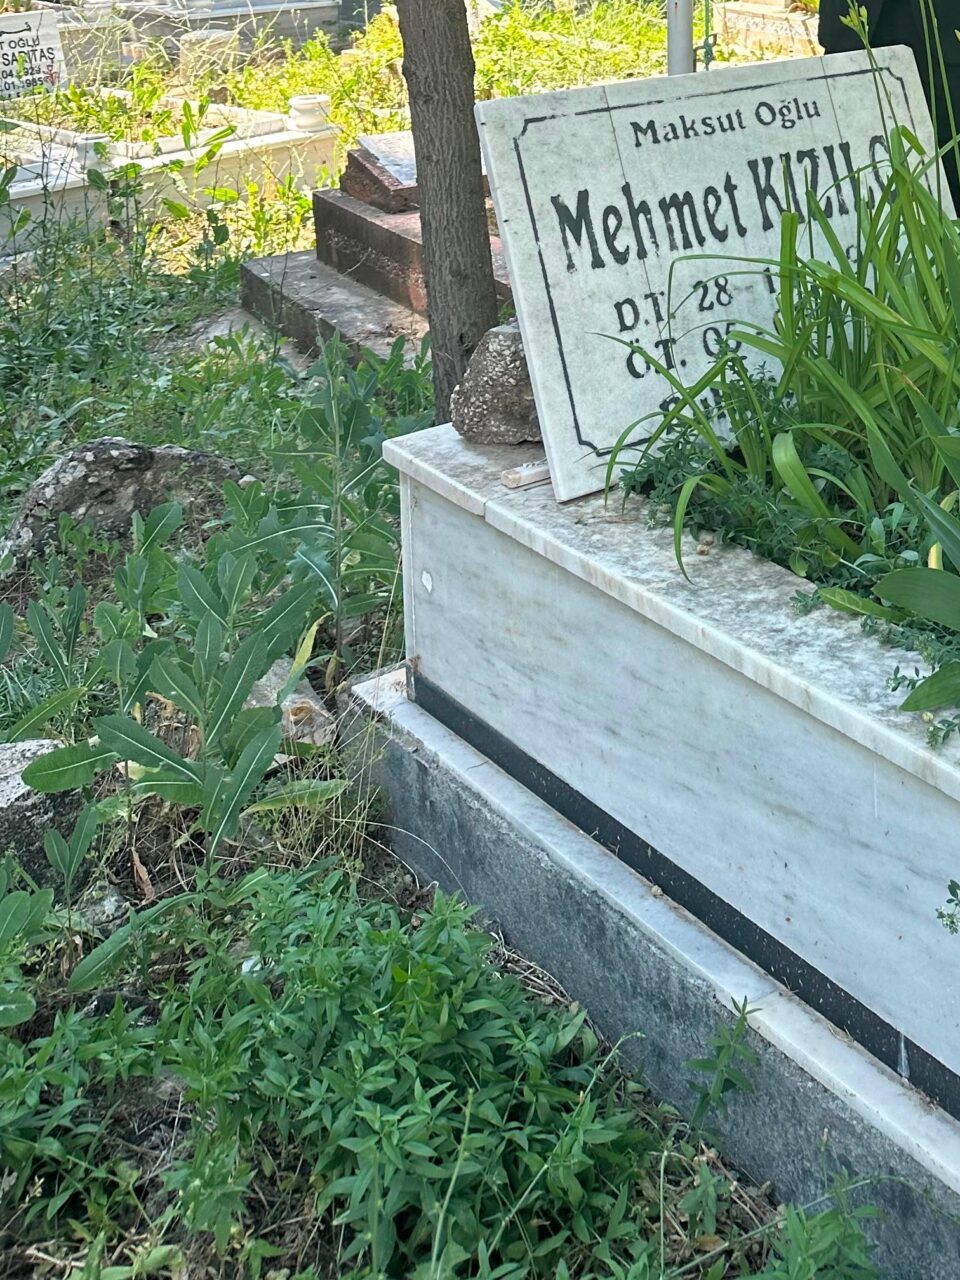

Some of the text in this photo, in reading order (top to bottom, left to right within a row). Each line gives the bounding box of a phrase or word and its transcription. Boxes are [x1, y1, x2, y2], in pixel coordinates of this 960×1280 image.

[8, 37, 40, 49] OĞLU
[630, 97, 821, 148] Maksut Oğlu
[550, 171, 748, 274] Mehmet
[692, 275, 733, 312] 28
